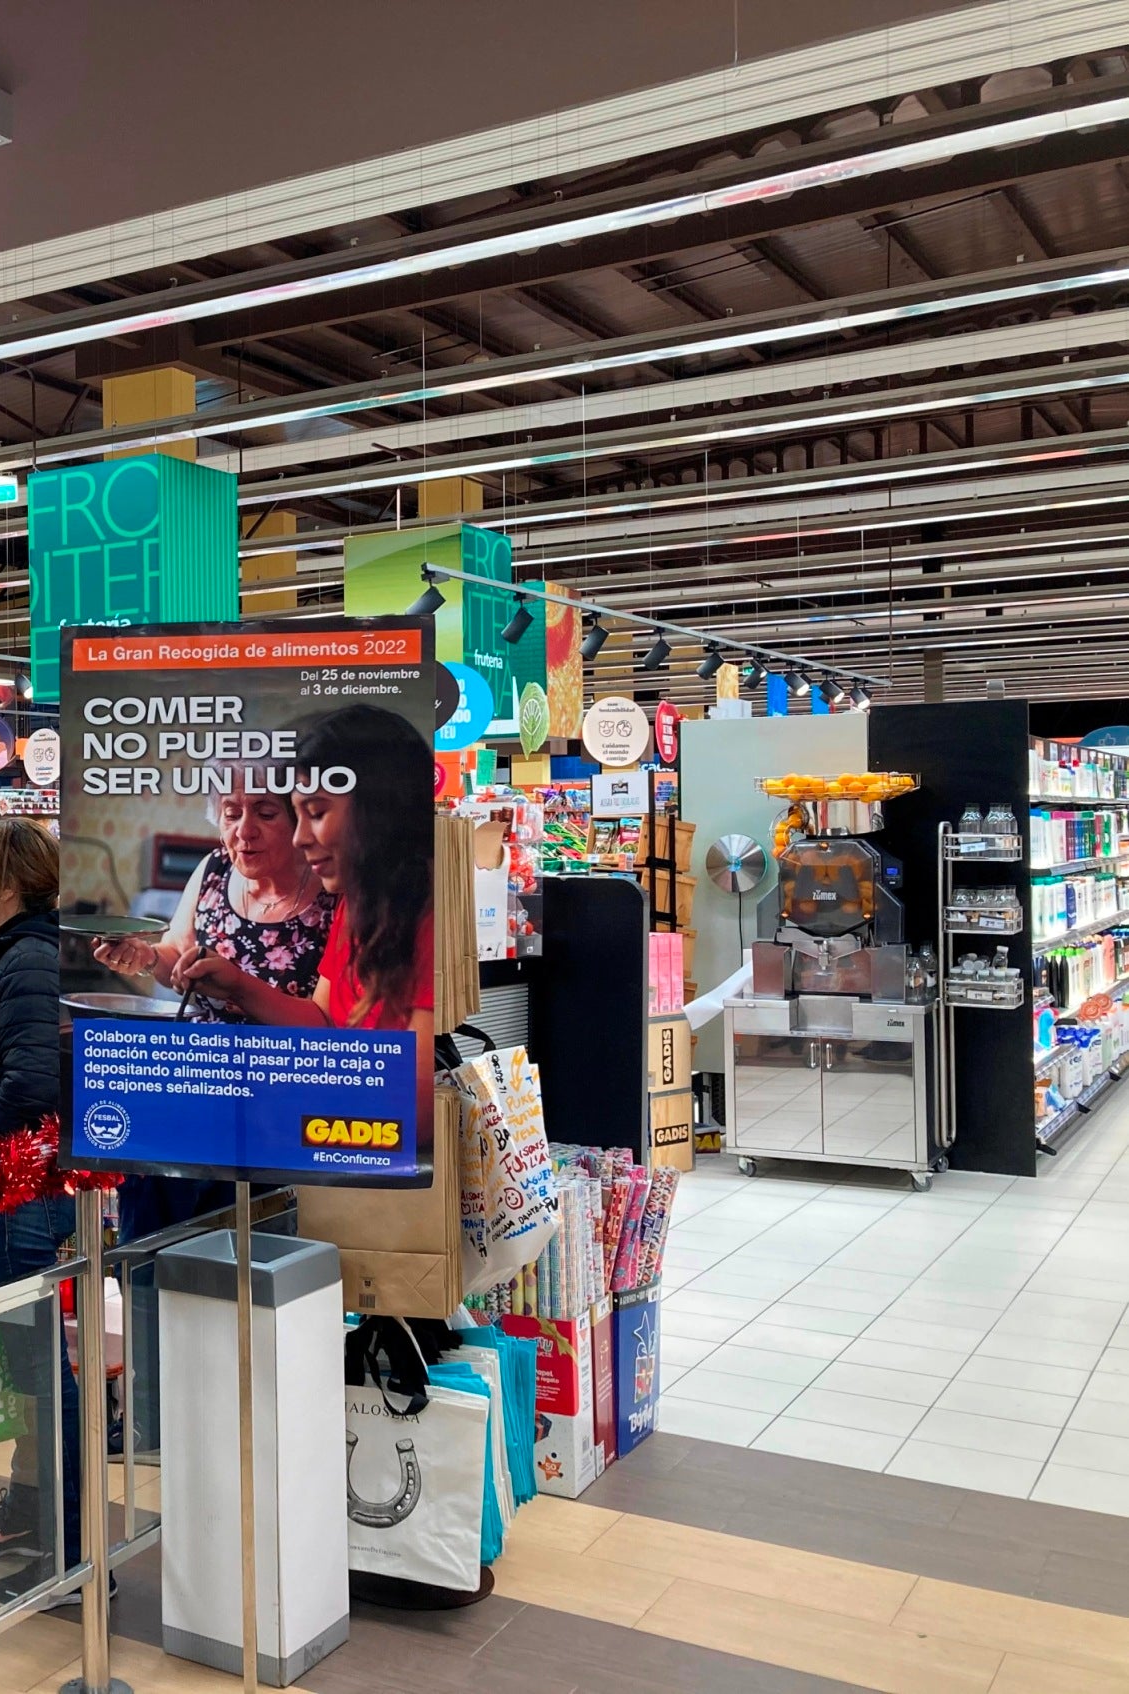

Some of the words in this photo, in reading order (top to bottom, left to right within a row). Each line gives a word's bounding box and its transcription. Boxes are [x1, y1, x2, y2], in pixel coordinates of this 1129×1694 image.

[88, 648, 107, 661] La
[113, 646, 152, 660] Gran
[159, 645, 239, 662] Recogida
[245, 643, 266, 658] de
[272, 643, 359, 657] alimentos
[364, 640, 406, 655] 2022
[301, 671, 319, 681] Del
[322, 669, 338, 681] 25
[341, 670, 355, 680] de
[359, 669, 420, 680] noviembre
[301, 686, 310, 696] al
[313, 684, 321, 695] 3
[325, 685, 338, 695] de
[342, 684, 402, 694] diciembre.
[83, 696, 243, 726] COMER
[83, 732, 148, 760] NO
[159, 731, 297, 760] PUEDE
[83, 767, 161, 795] SER
[173, 767, 233, 795] UN
[244, 766, 358, 795] LUJO
[84, 1029, 146, 1044] Colabora
[150, 1035, 167, 1044] en
[171, 1033, 185, 1045] tu
[189, 1034, 230, 1047] Gadis
[234, 1036, 296, 1052] habitual,
[301, 1038, 369, 1053] haciendo
[373, 1043, 402, 1054] una
[84, 1045, 148, 1060] donación
[152, 1049, 229, 1063] económica
[233, 1052, 245, 1064] al
[249, 1054, 290, 1067] pasar
[294, 1057, 319, 1069] por
[324, 1056, 336, 1068] la
[340, 1057, 371, 1072] caja
[375, 1060, 385, 1070] o
[663, 1029, 672, 1082] GADIS
[84, 1061, 170, 1076] depositando
[173, 1065, 243, 1080] alimentos
[247, 1071, 265, 1081] no
[270, 1072, 361, 1086] perecederos
[365, 1076, 384, 1086] en
[84, 1077, 105, 1089] los
[108, 1079, 162, 1094] cajones
[166, 1081, 254, 1097] señalizados.
[306, 1118, 399, 1148] GADIS
[656, 1126, 689, 1144] GADIS
[313, 1151, 390, 1166] #EnConfianza
